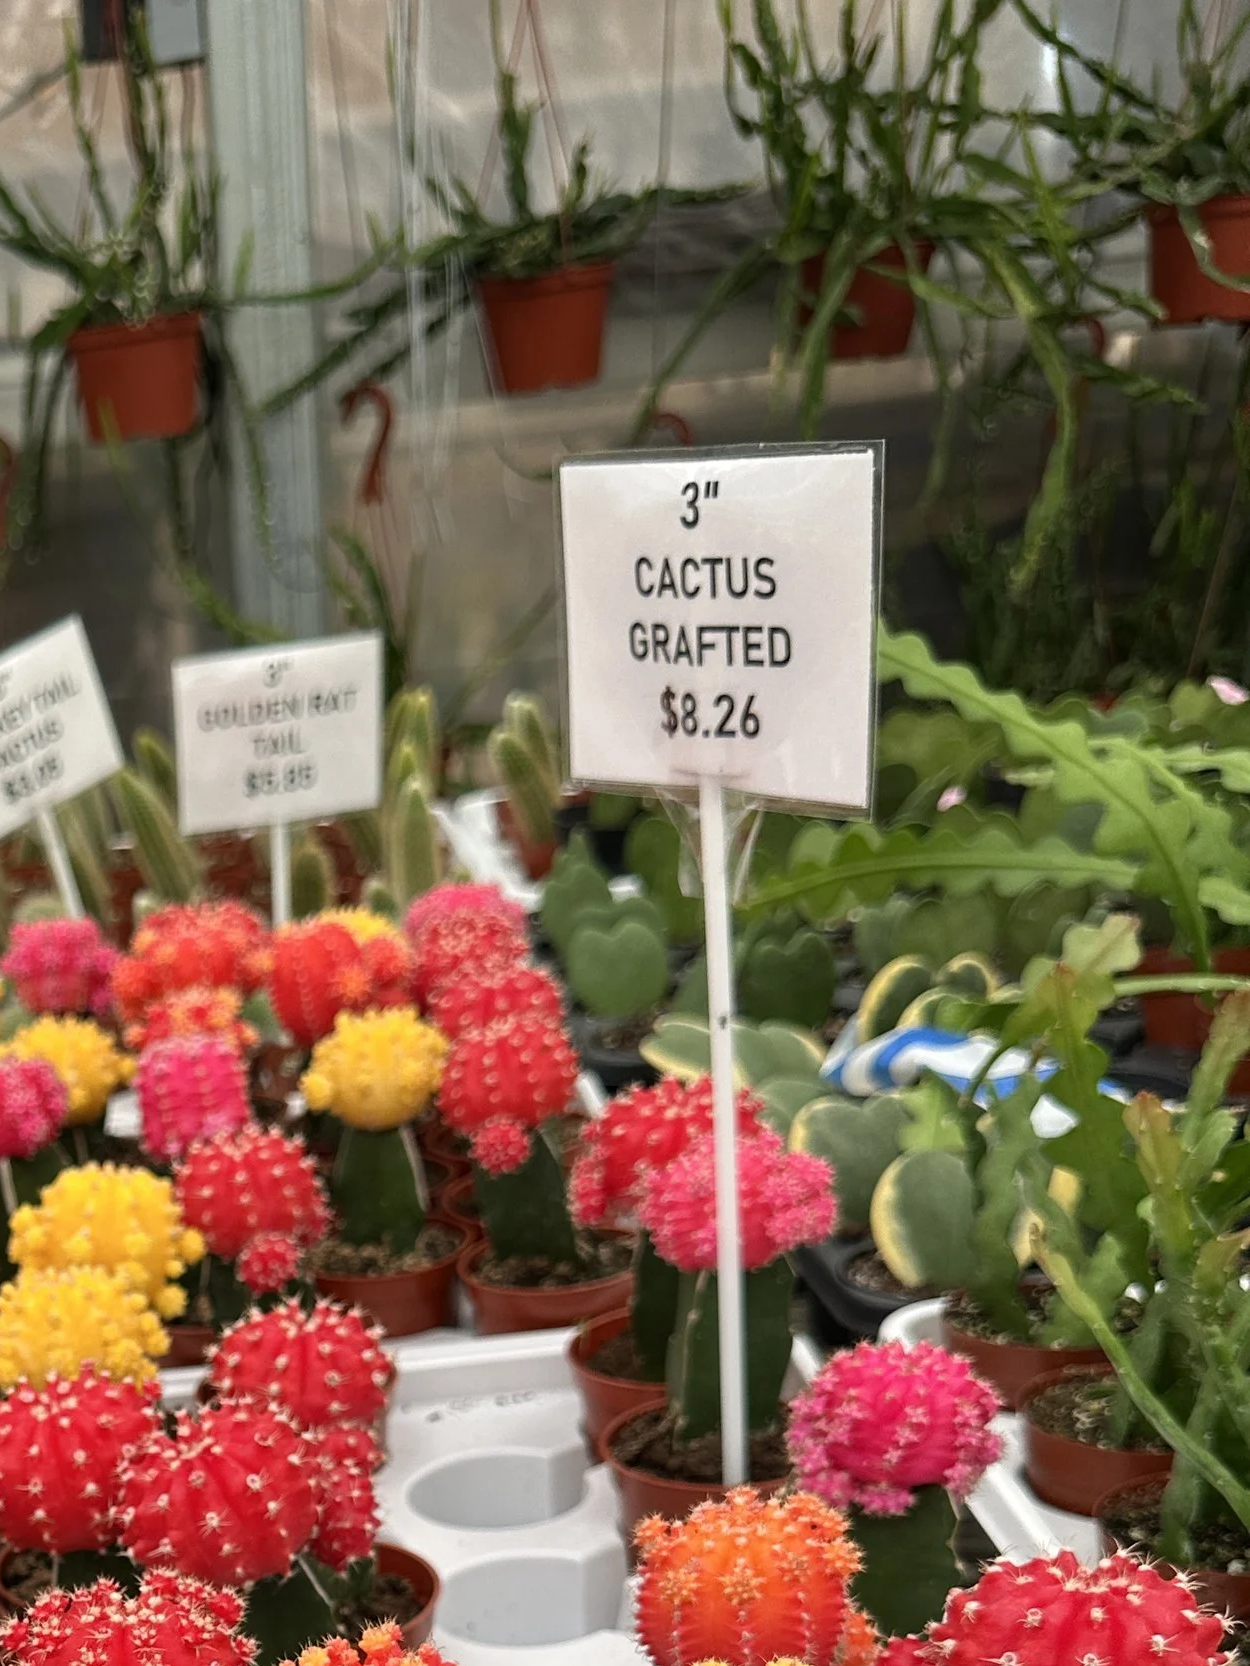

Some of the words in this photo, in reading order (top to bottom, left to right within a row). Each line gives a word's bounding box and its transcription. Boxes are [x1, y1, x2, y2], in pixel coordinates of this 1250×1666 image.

[679, 479, 720, 530] 3"
[634, 556, 777, 600] CACTUS
[628, 621, 792, 668] GRAFTED
[196, 694, 303, 733] GOLDEN
[307, 683, 359, 717] RAT
[660, 684, 761, 740] $8.26
[250, 726, 307, 761] TAIL
